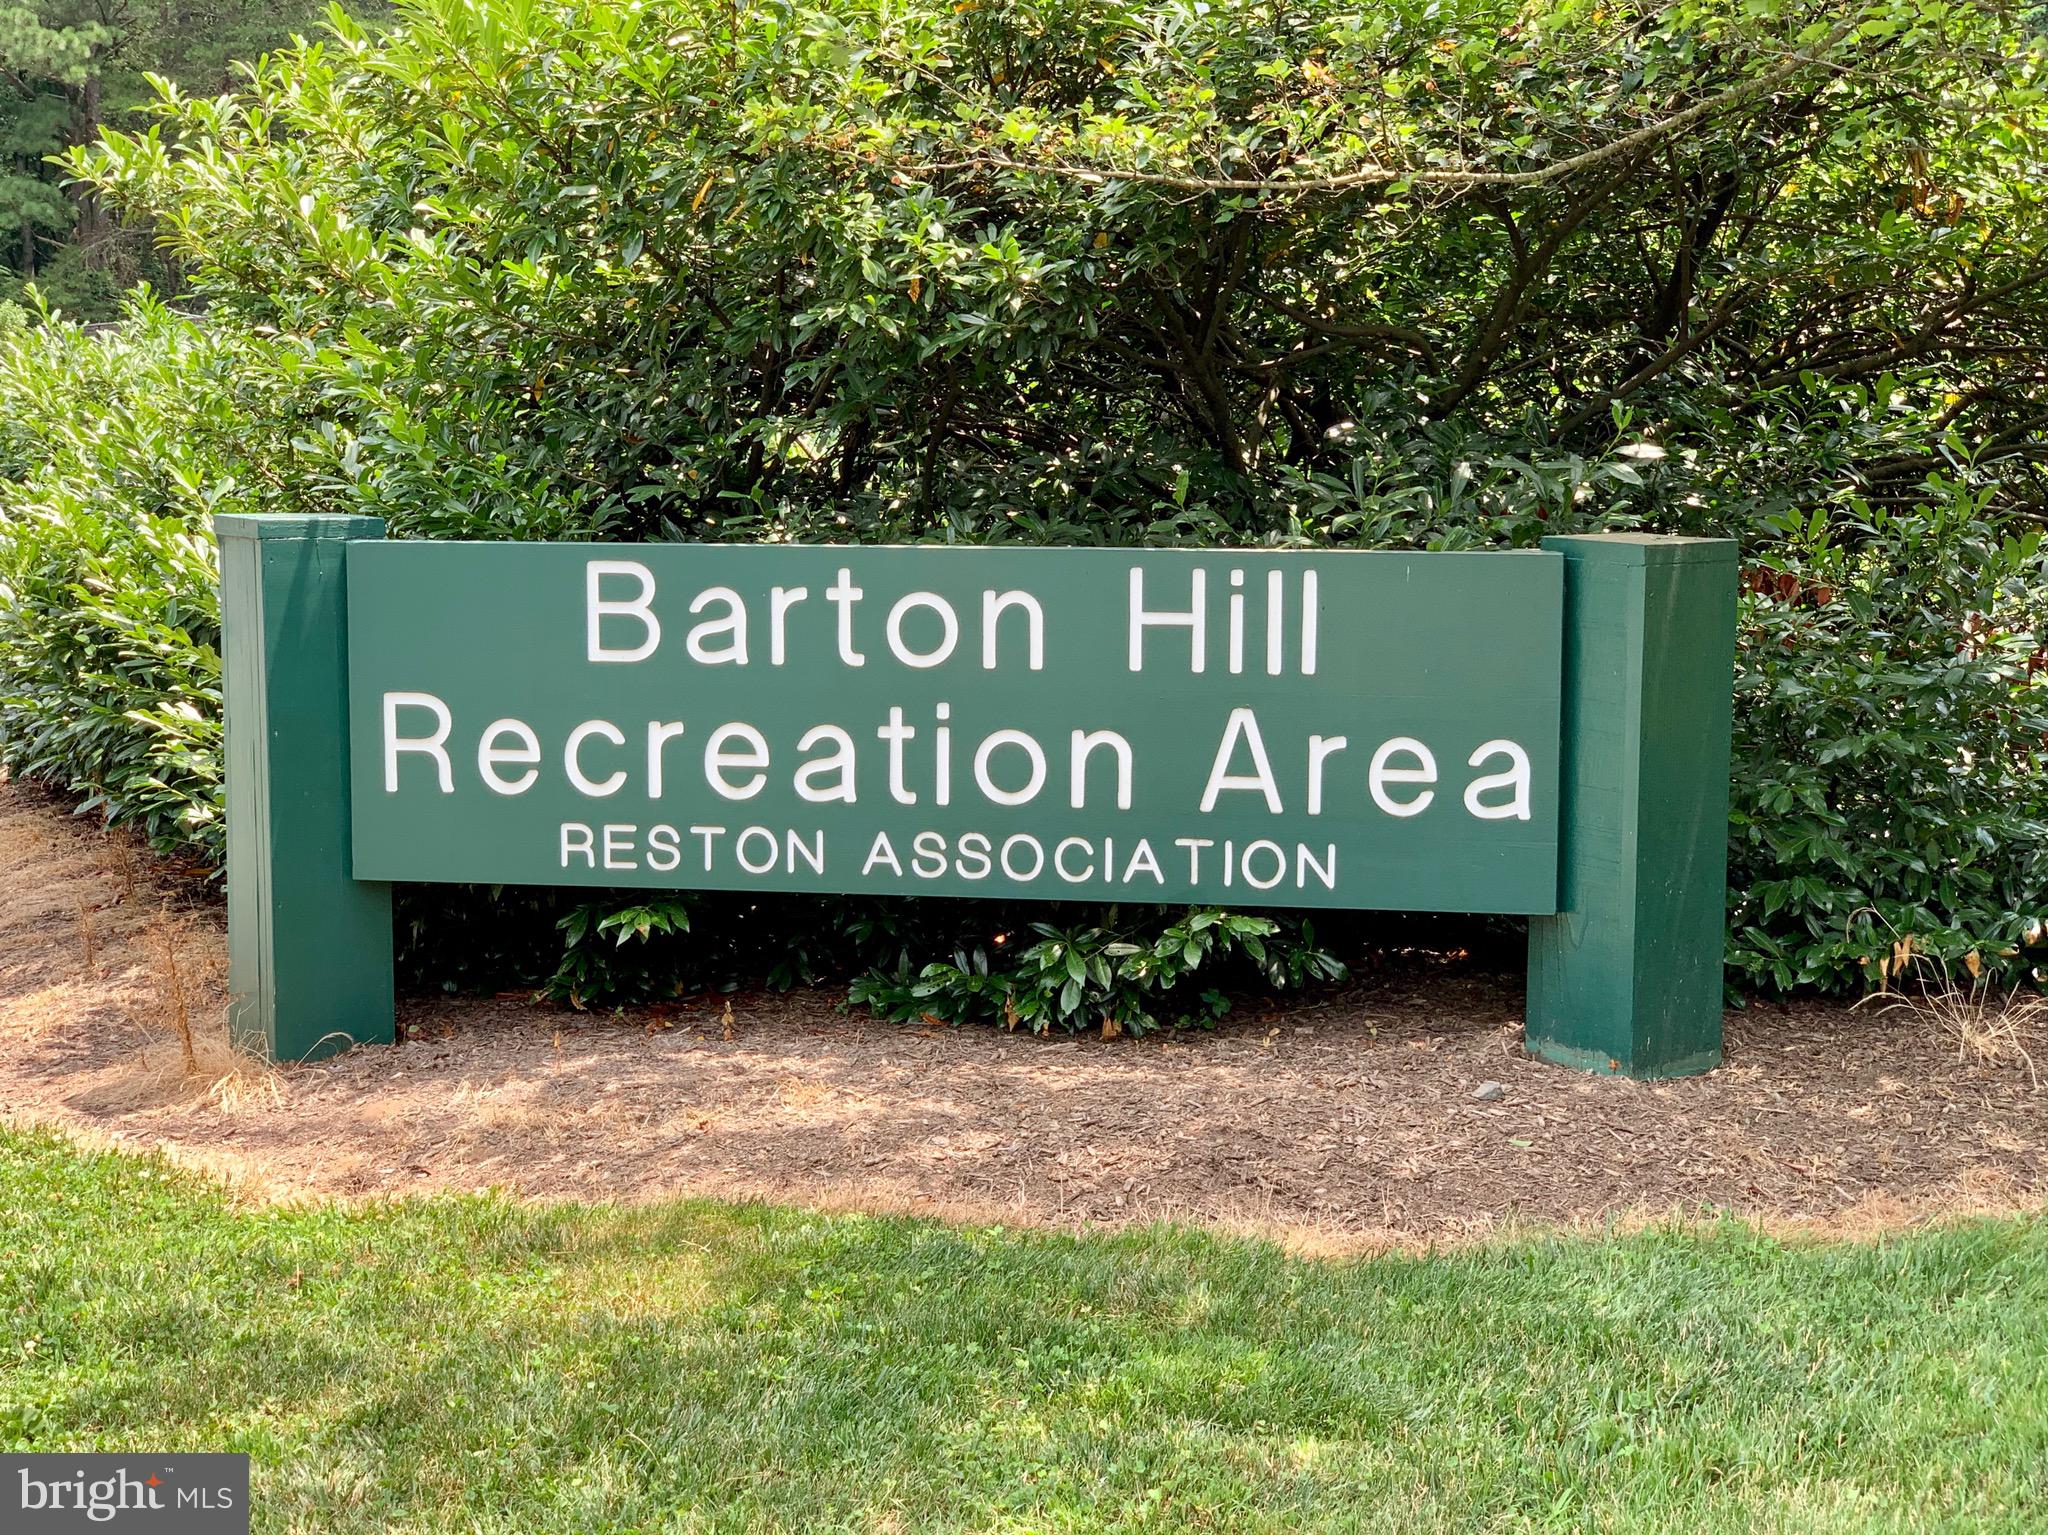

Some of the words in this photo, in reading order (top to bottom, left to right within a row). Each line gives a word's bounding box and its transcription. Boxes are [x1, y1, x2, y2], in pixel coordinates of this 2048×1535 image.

[585, 559, 1045, 672] Barton
[1127, 565, 1319, 677] Hill
[382, 691, 1135, 811] Recreation
[1198, 706, 1532, 822] Area
[559, 821, 826, 876] RESTON
[860, 830, 1338, 891] ASSOCIATION
